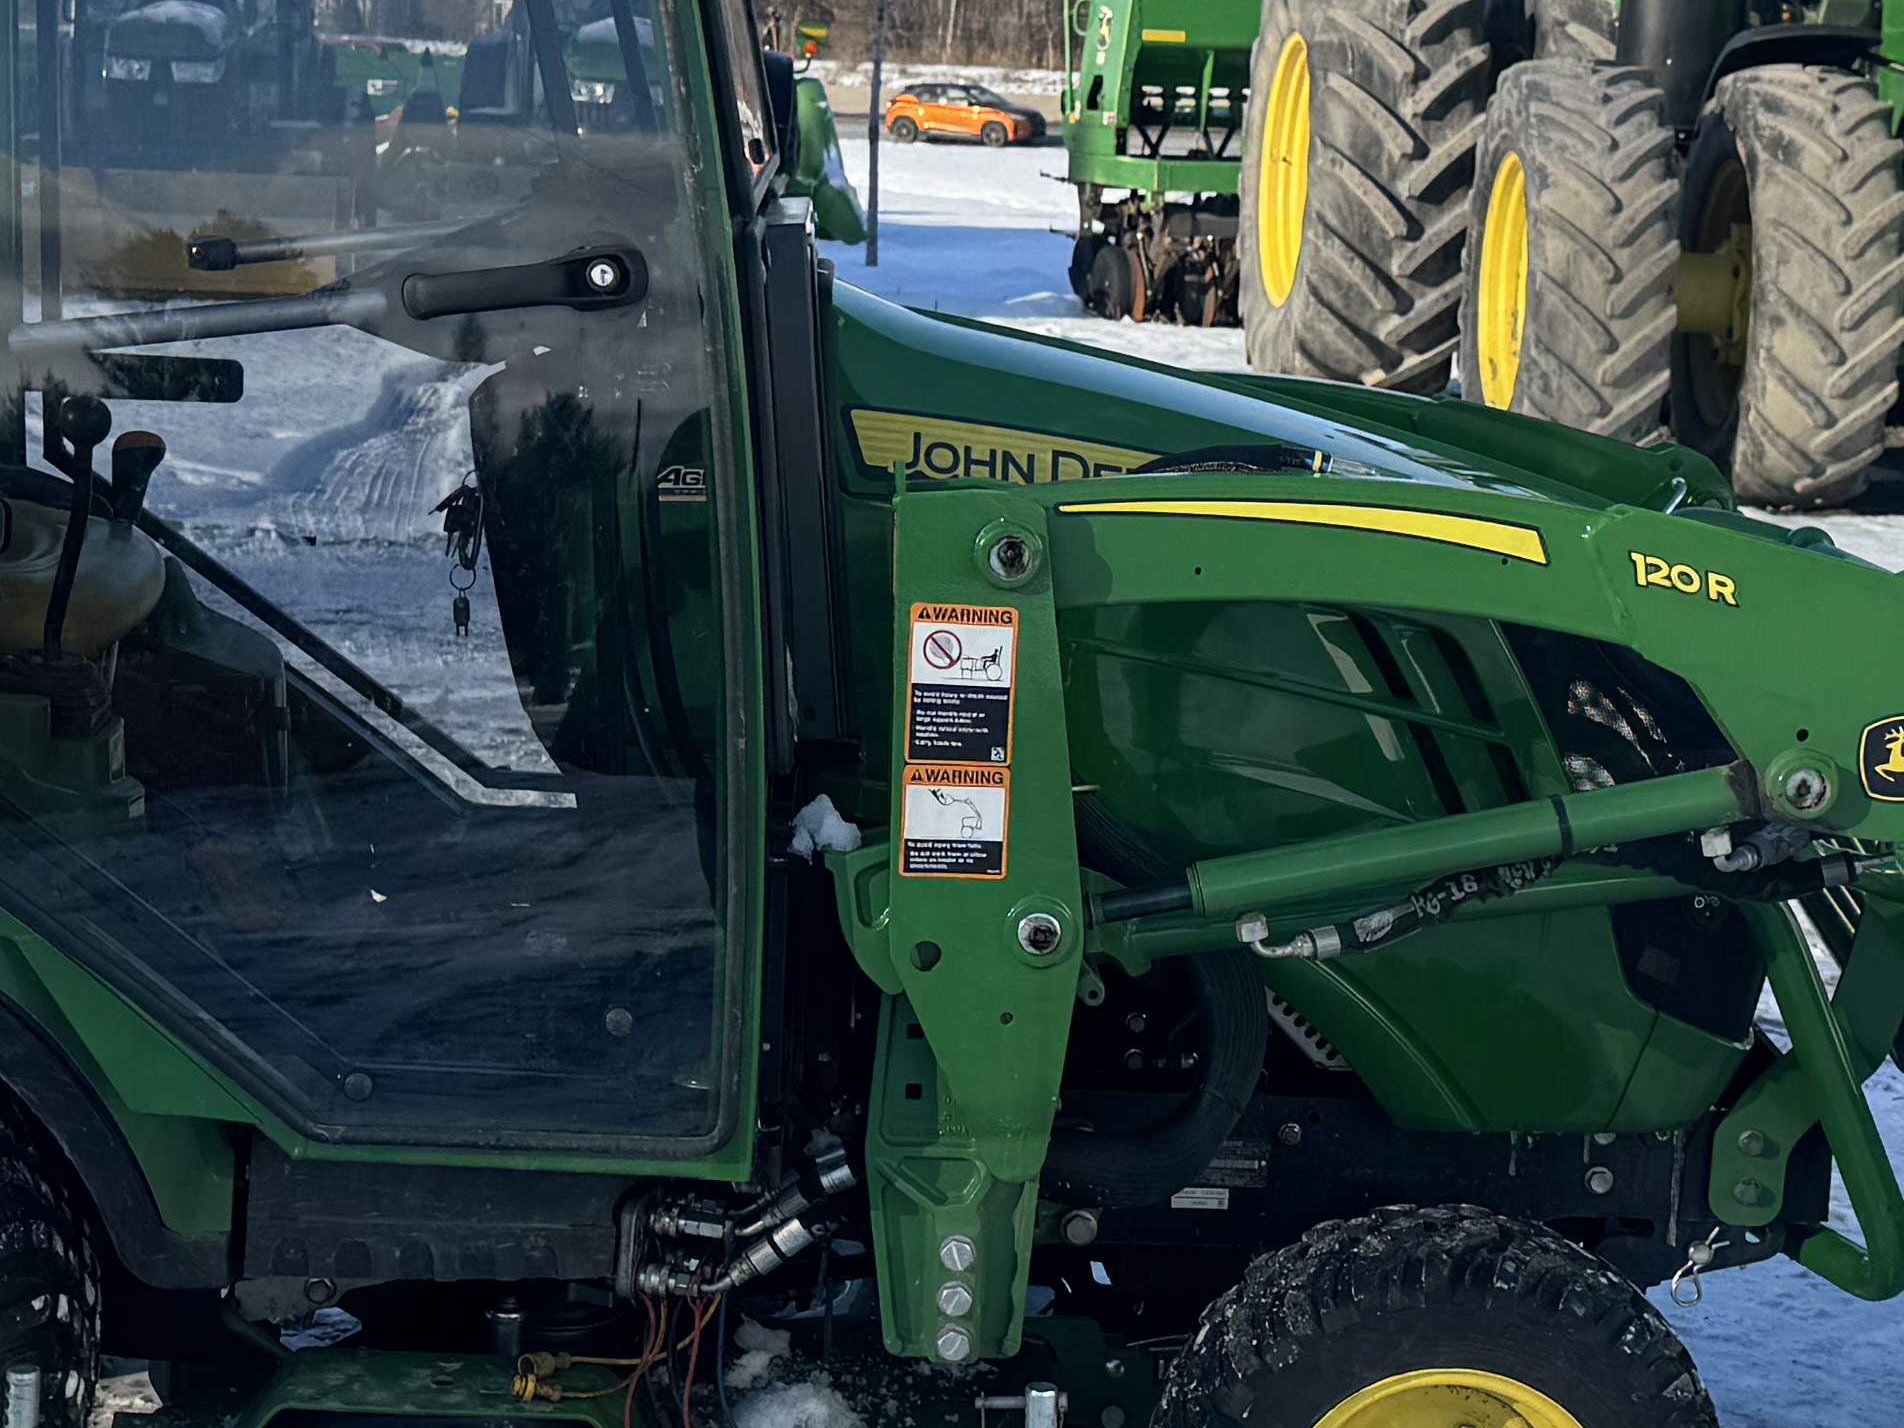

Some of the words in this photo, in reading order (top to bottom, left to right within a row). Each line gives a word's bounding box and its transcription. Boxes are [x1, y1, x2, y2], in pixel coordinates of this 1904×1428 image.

[894, 431, 1036, 484] JOHN
[933, 606, 1013, 625] WARNING
[925, 768, 1004, 785] WARNING
